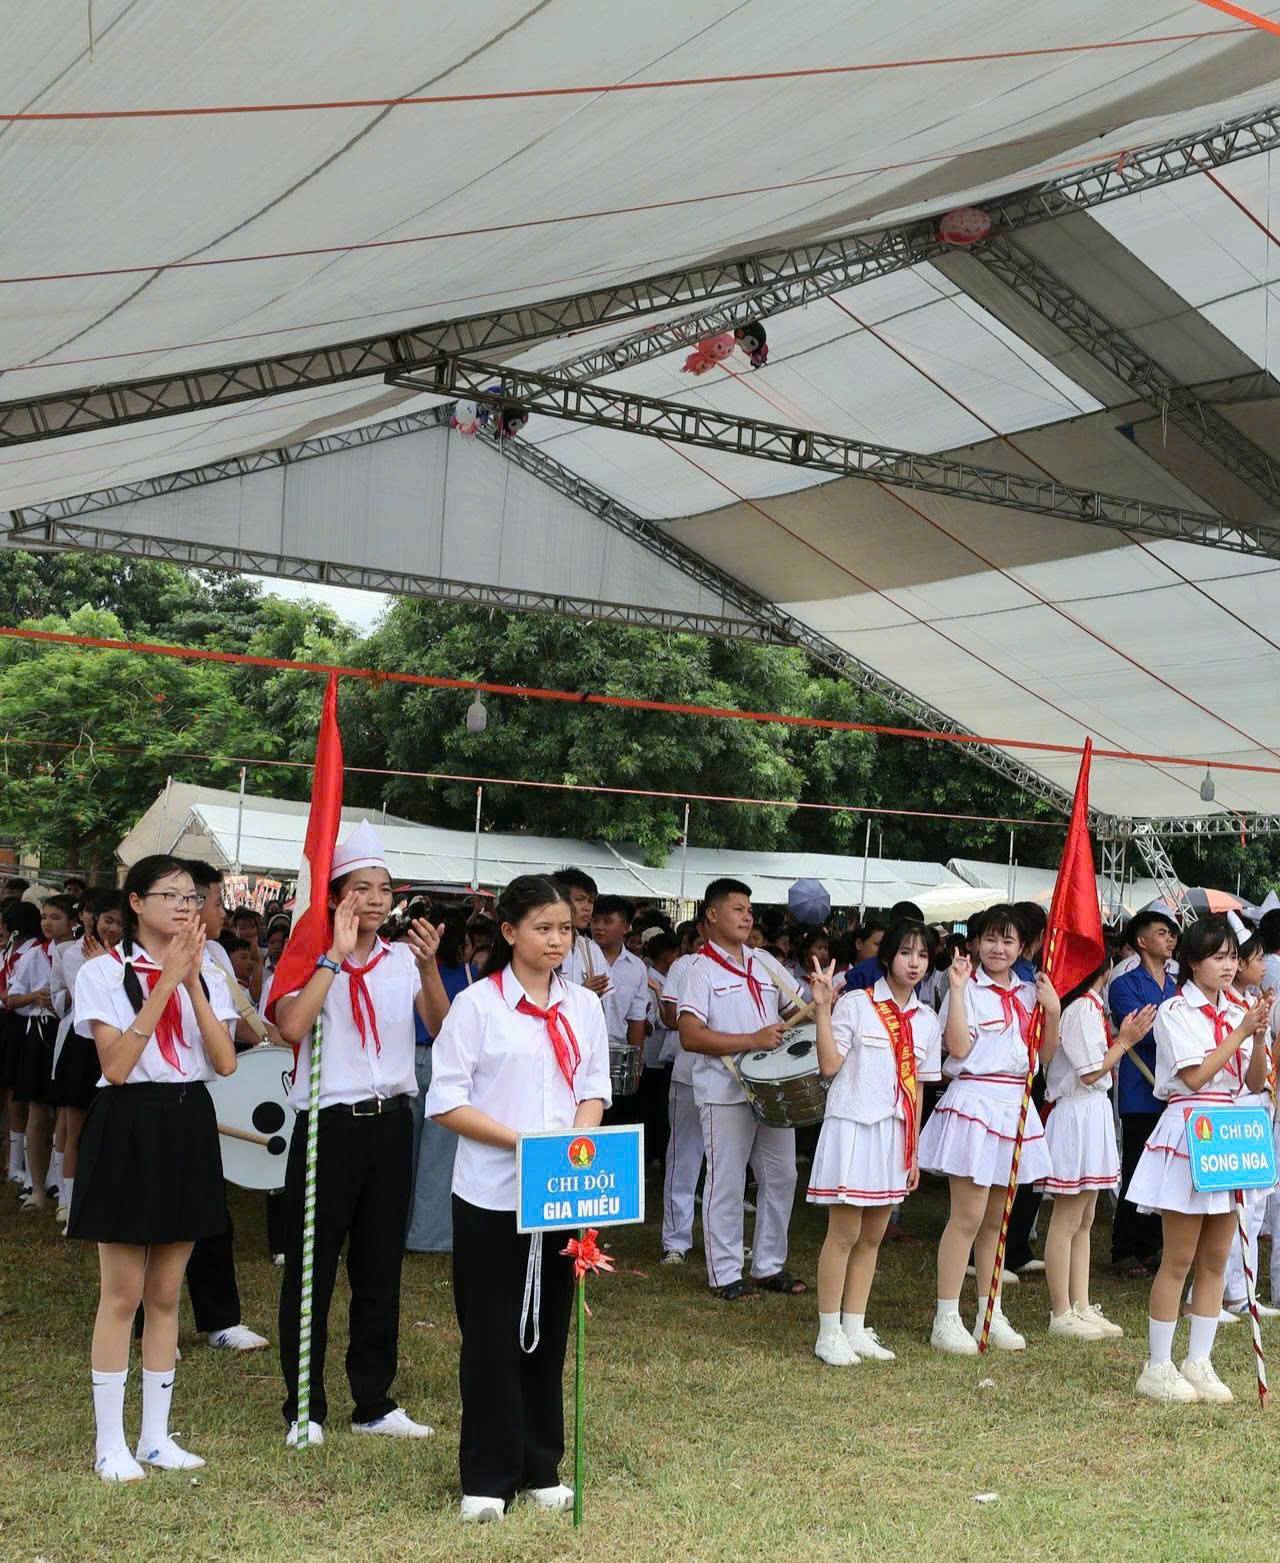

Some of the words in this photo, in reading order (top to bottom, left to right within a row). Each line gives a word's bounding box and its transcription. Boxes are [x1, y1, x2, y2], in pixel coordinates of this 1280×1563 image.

[1219, 1124, 1241, 1140] CHI
[1244, 1120, 1264, 1141] ĐỘI
[1200, 1153, 1239, 1173] SONG
[1241, 1151, 1269, 1170] NGA
[547, 1175, 579, 1193] CHI
[583, 1169, 616, 1193] ĐỘI
[543, 1201, 573, 1220] GIA
[577, 1194, 620, 1217] MIÊU
